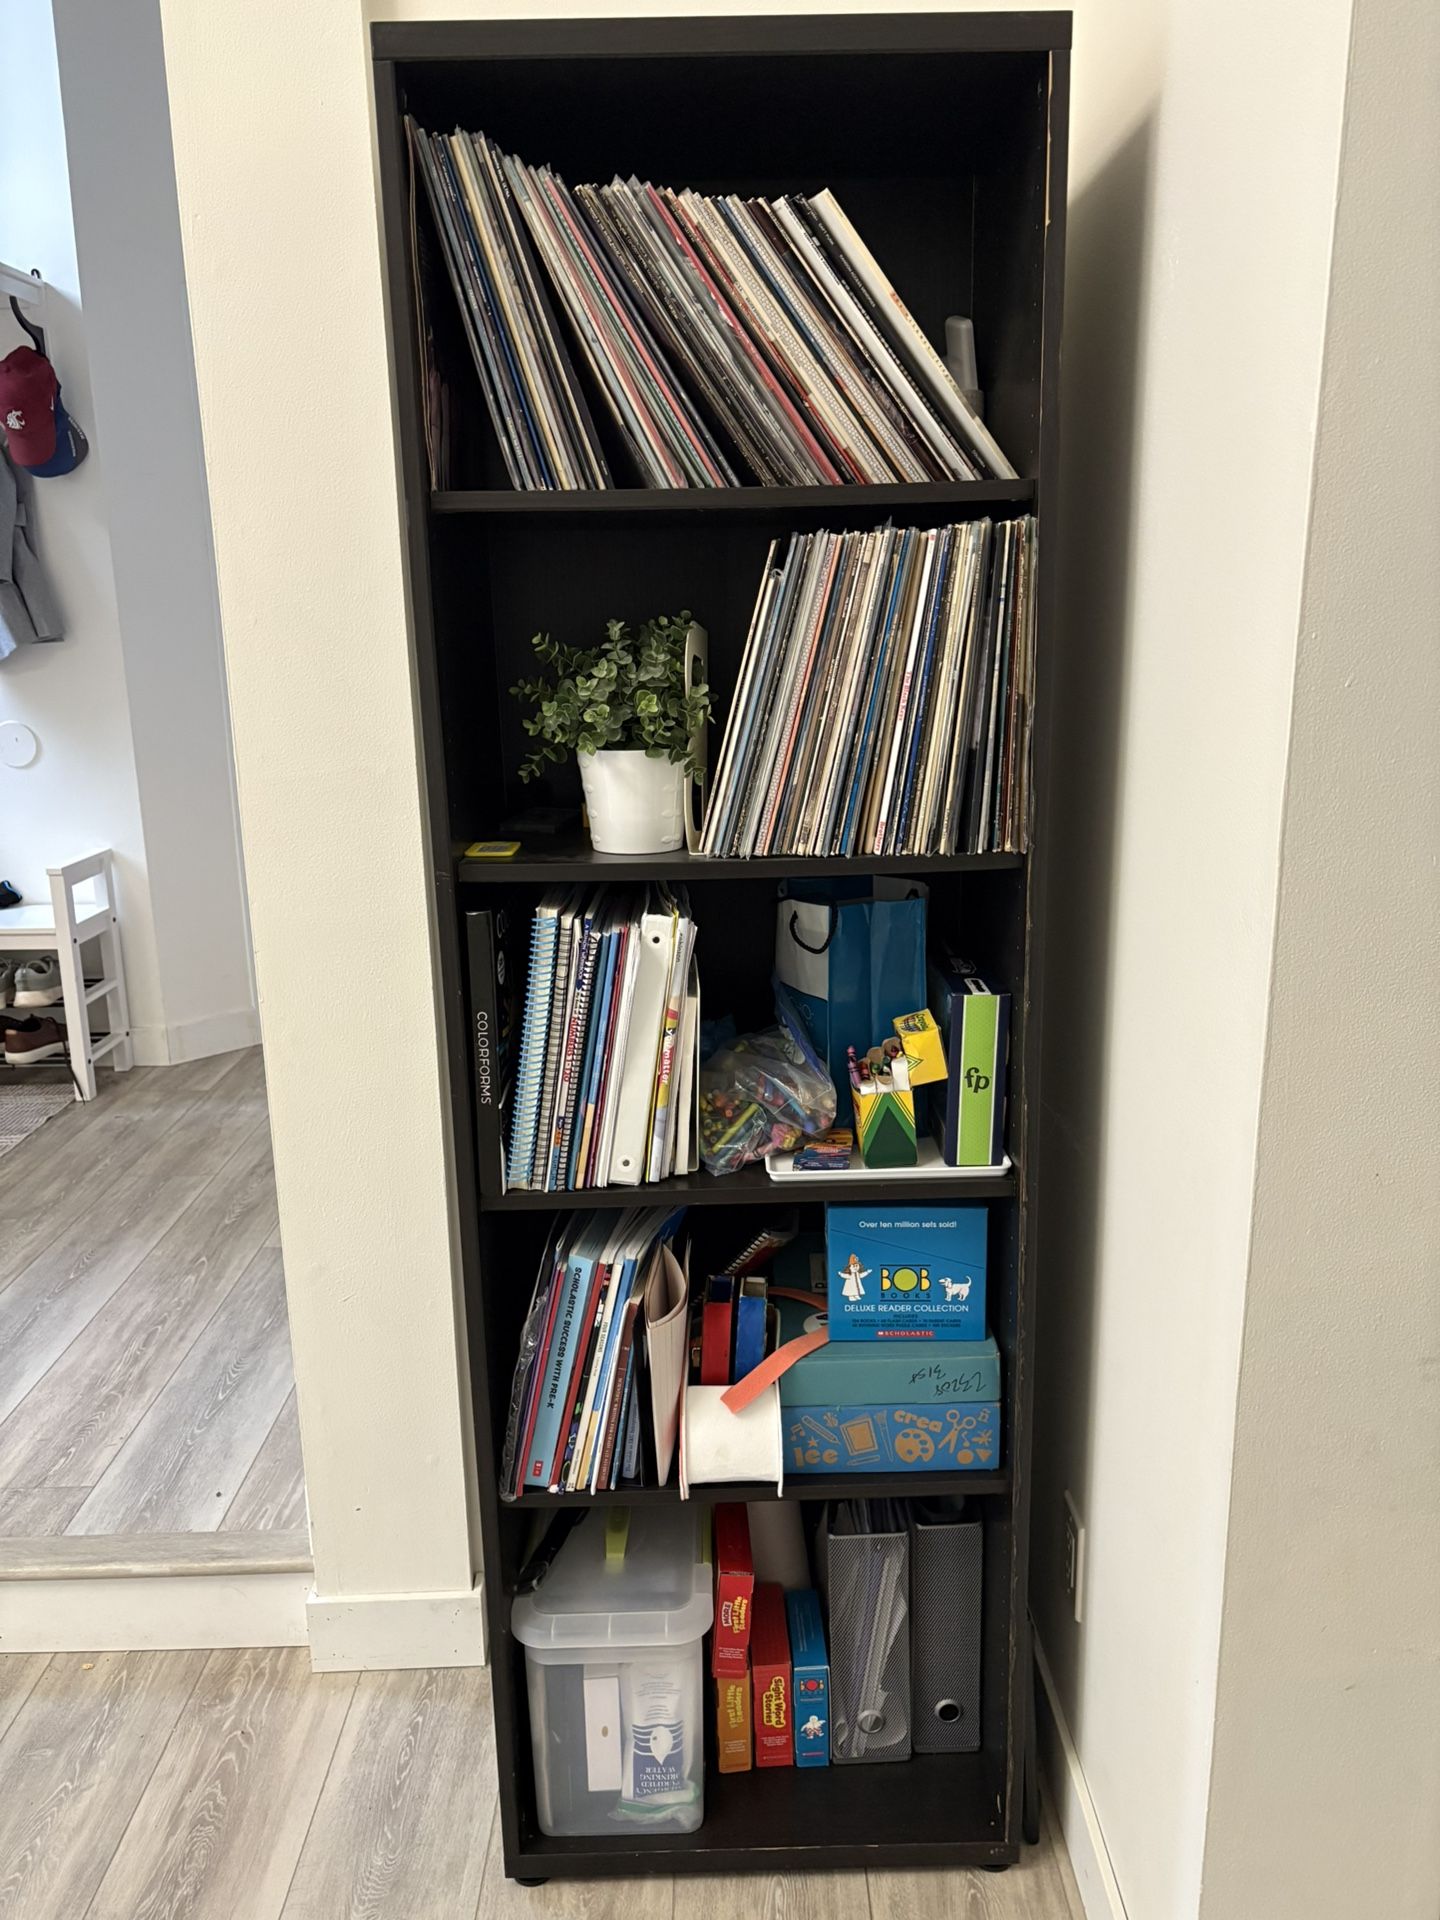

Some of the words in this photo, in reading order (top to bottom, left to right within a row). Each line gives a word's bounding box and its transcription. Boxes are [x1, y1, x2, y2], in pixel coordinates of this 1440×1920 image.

[904, 671, 912, 683] The
[901, 684, 909, 703] Black
[898, 704, 906, 721] Keys
[874, 821, 885, 851] Brothers
[477, 1011, 492, 1104] COLORFORMS
[964, 1067, 990, 1093] fp
[880, 1267, 931, 1292] BOB
[565, 1267, 582, 1318] SCHOLASTIC
[601, 1321, 609, 1332] FOUR
[558, 1320, 571, 1358] SUCCESS
[597, 1333, 607, 1353] SEASONS
[553, 1359, 563, 1382] WITH
[546, 1383, 559, 1409] PRE-K
[893, 1409, 943, 1433] crea
[794, 1447, 839, 1467] lee
[723, 1603, 732, 1625] MORE
[734, 1595, 743, 1615] Little
[739, 1598, 748, 1630] Readers
[732, 1615, 743, 1633] First
[728, 1684, 737, 1708] Little
[772, 1678, 784, 1700] Sight
[734, 1686, 744, 1724] Readers
[765, 1693, 774, 1723] Stories
[775, 1702, 785, 1725] Word
[728, 1708, 739, 1728] First
